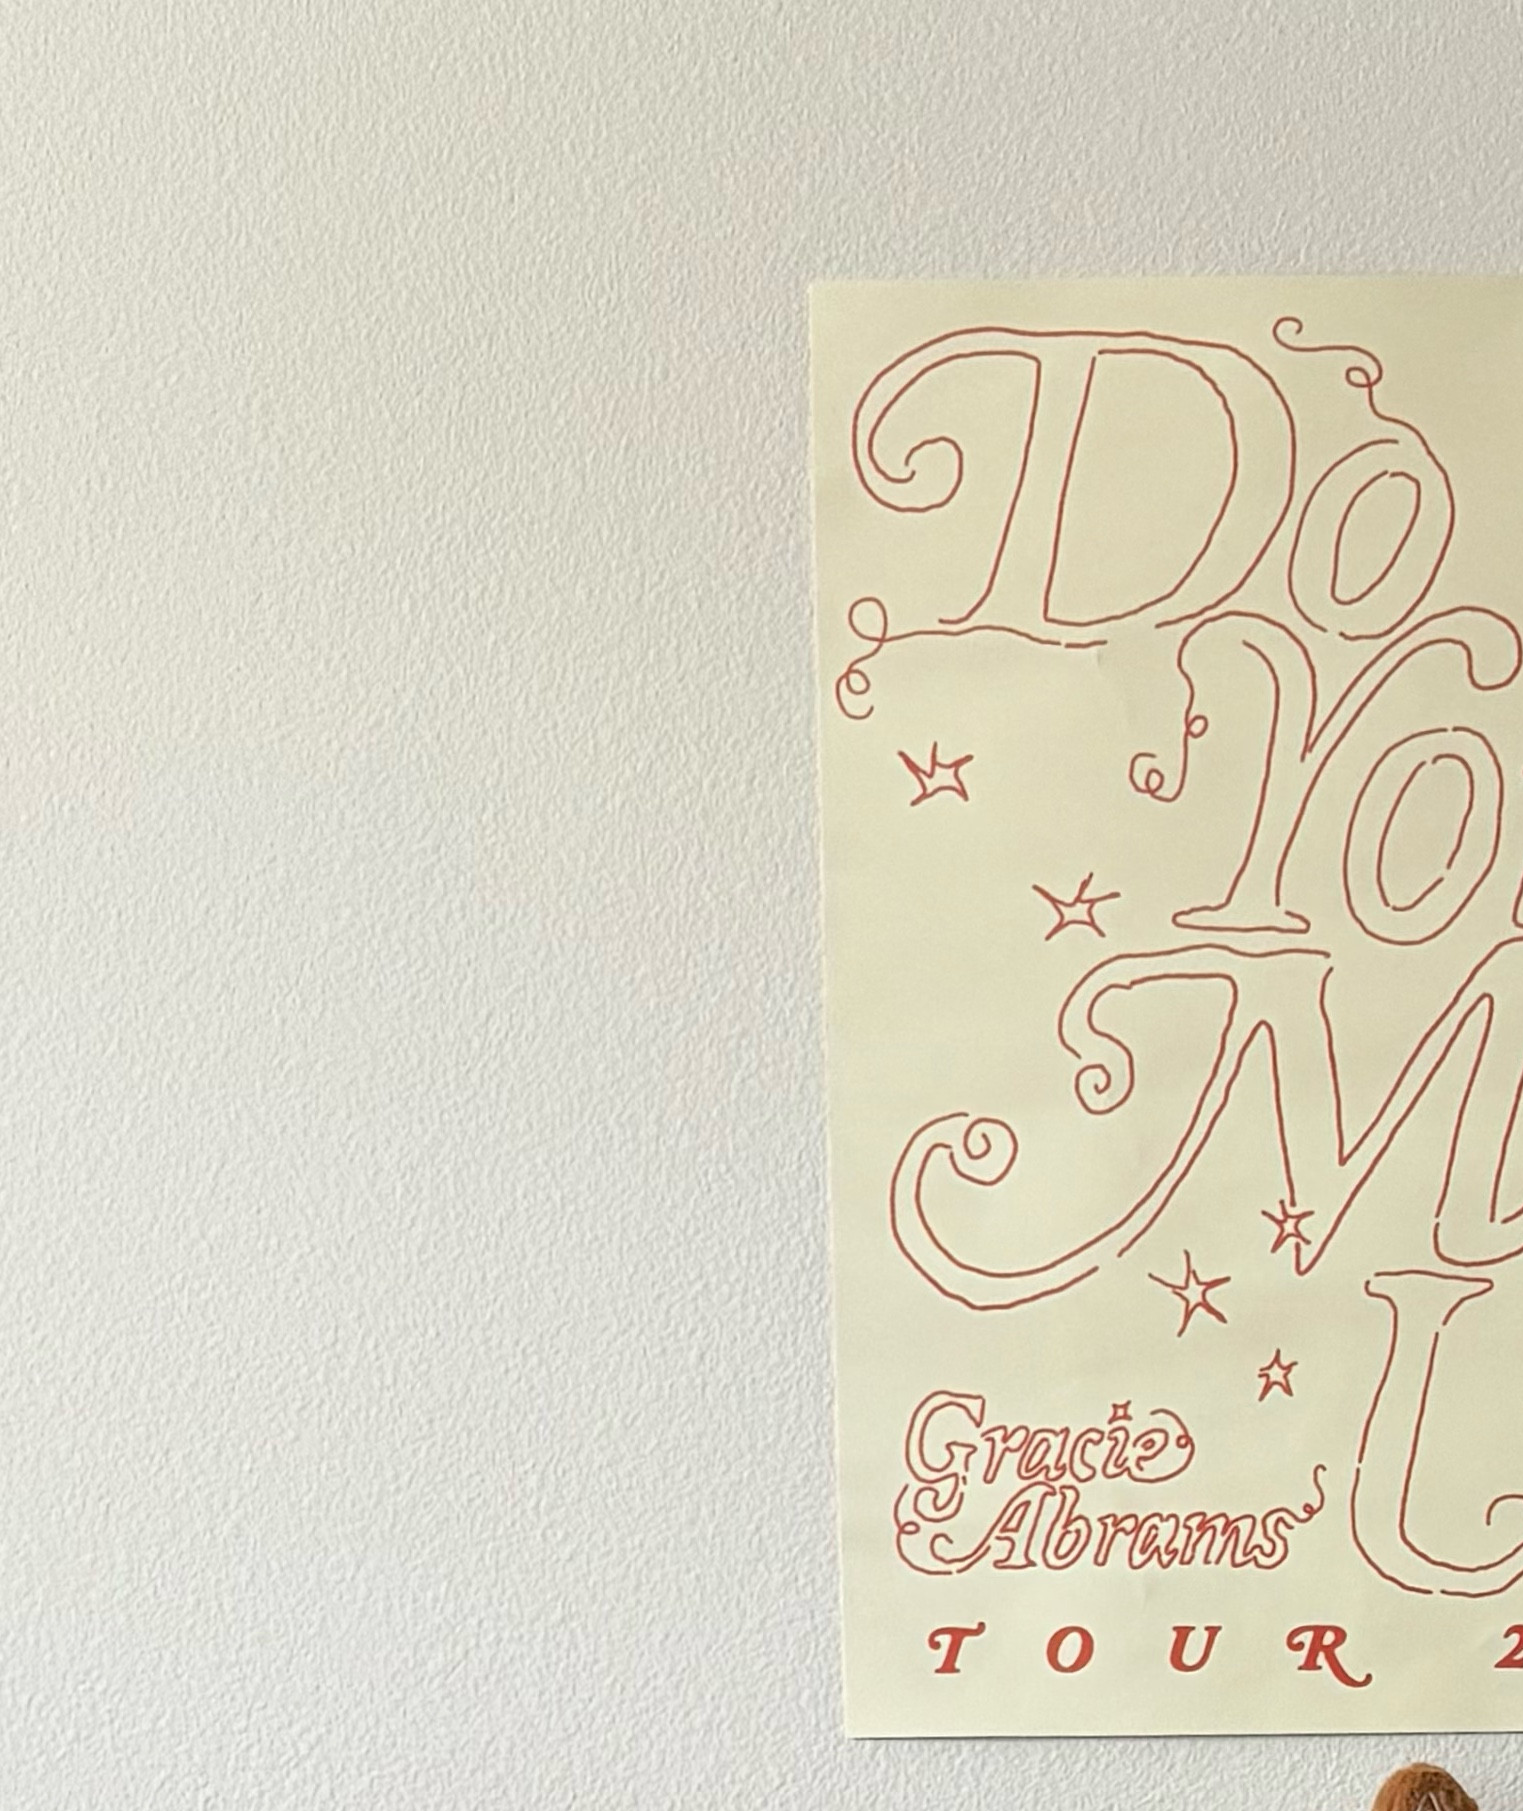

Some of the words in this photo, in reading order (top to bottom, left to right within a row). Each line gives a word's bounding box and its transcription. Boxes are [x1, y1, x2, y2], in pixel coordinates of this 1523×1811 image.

[837, 317, 1454, 719] Do
[905, 1390, 1195, 1521] Gracie
[894, 1464, 1327, 1575] Abrams
[928, 1623, 1373, 1688] TOUR
